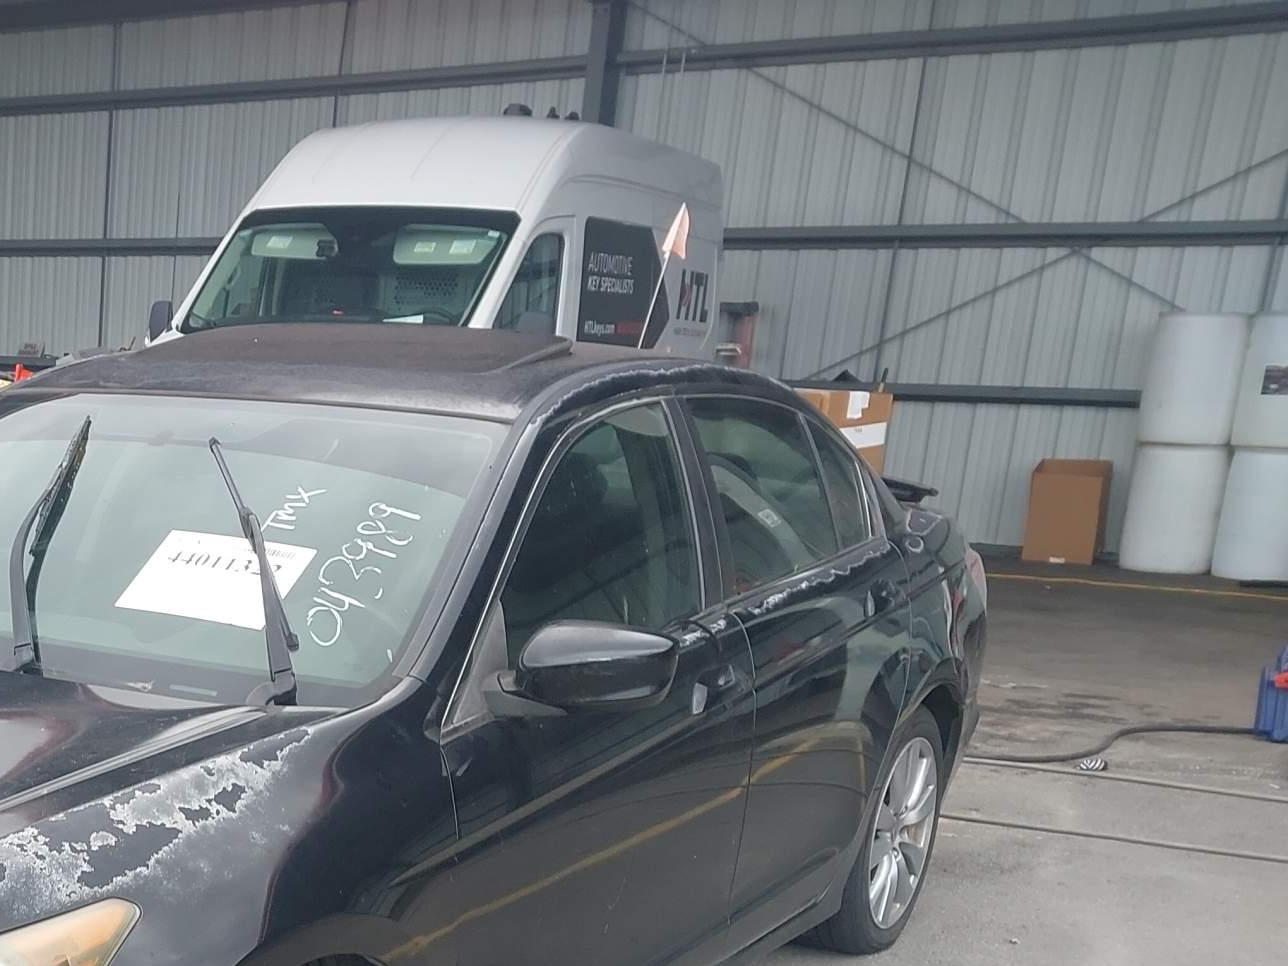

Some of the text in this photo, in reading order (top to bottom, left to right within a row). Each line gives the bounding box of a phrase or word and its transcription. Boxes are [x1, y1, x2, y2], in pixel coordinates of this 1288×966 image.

[587, 251, 633, 276] AUTOMOTIVE
[587, 275, 635, 295] KEY SPECIALISTS
